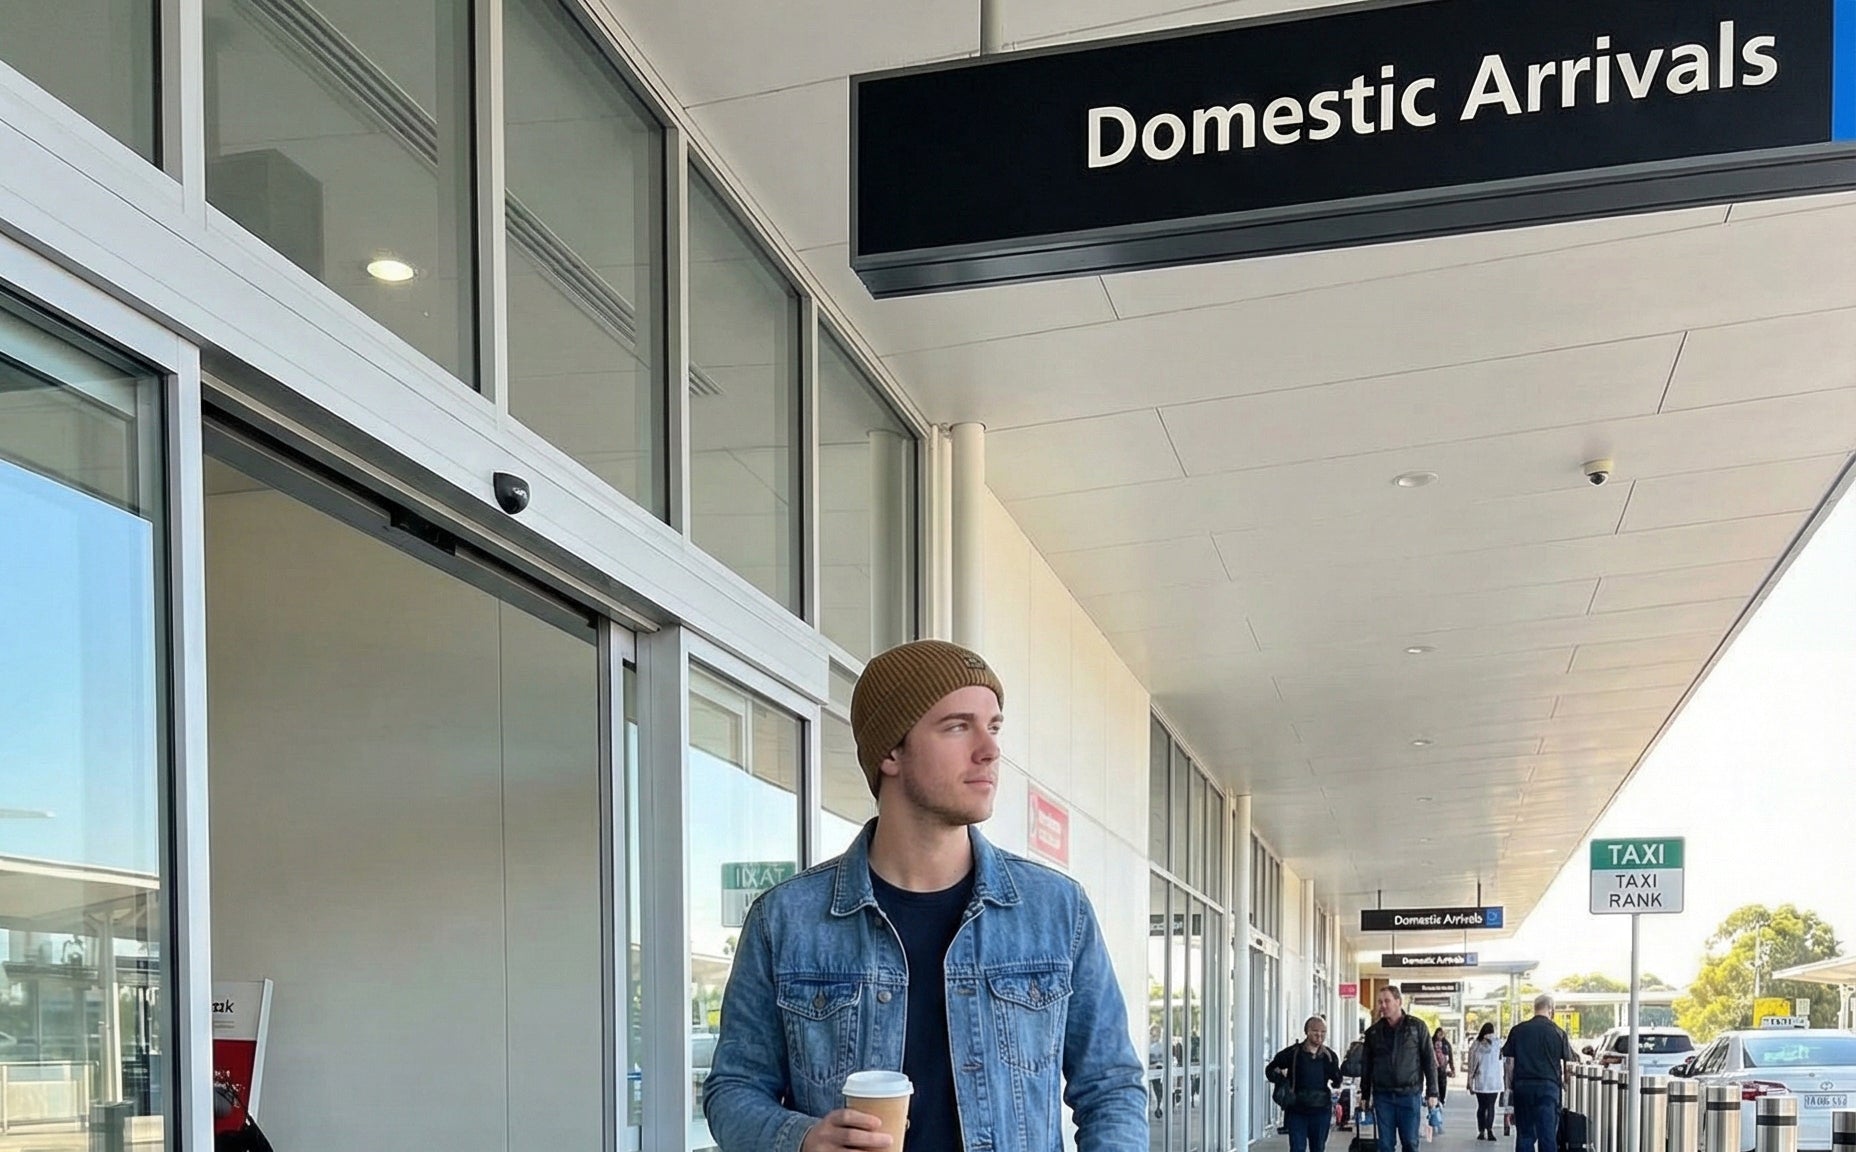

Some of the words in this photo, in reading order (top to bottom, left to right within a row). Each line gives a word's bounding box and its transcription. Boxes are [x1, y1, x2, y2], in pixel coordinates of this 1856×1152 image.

[1088, 65, 1437, 168] Domestic
[1460, 20, 1778, 122] Arrivals
[1608, 843, 1664, 865] TAXI
[1615, 873, 1657, 888] TAXI
[1609, 893, 1662, 908] RANK
